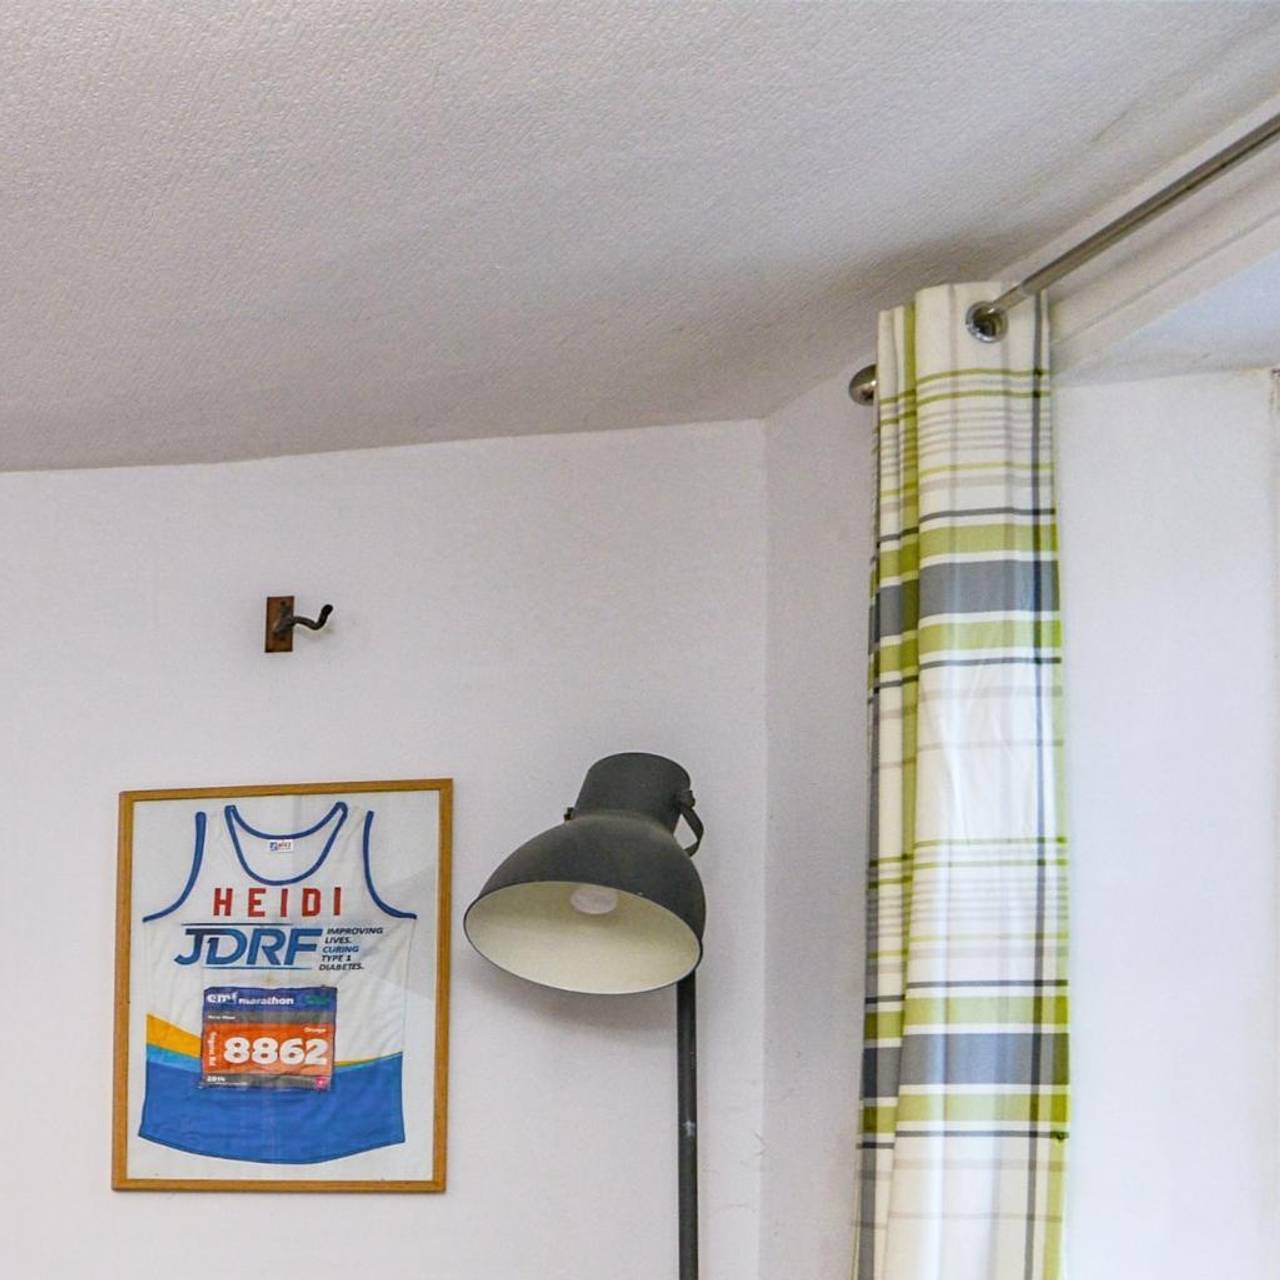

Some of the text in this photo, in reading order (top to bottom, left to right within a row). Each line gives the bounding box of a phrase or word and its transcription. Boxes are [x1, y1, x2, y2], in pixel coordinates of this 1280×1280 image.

[213, 886, 341, 917] HEIDI
[326, 927, 384, 935] IMPROVING
[324, 936, 352, 944] LIVES.
[174, 928, 323, 965] JDRF
[322, 945, 359, 953] CURING
[321, 954, 342, 962] TYPE
[318, 962, 365, 971] DIABETES.
[238, 996, 294, 1005] marathon
[223, 1036, 329, 1065] 8862
